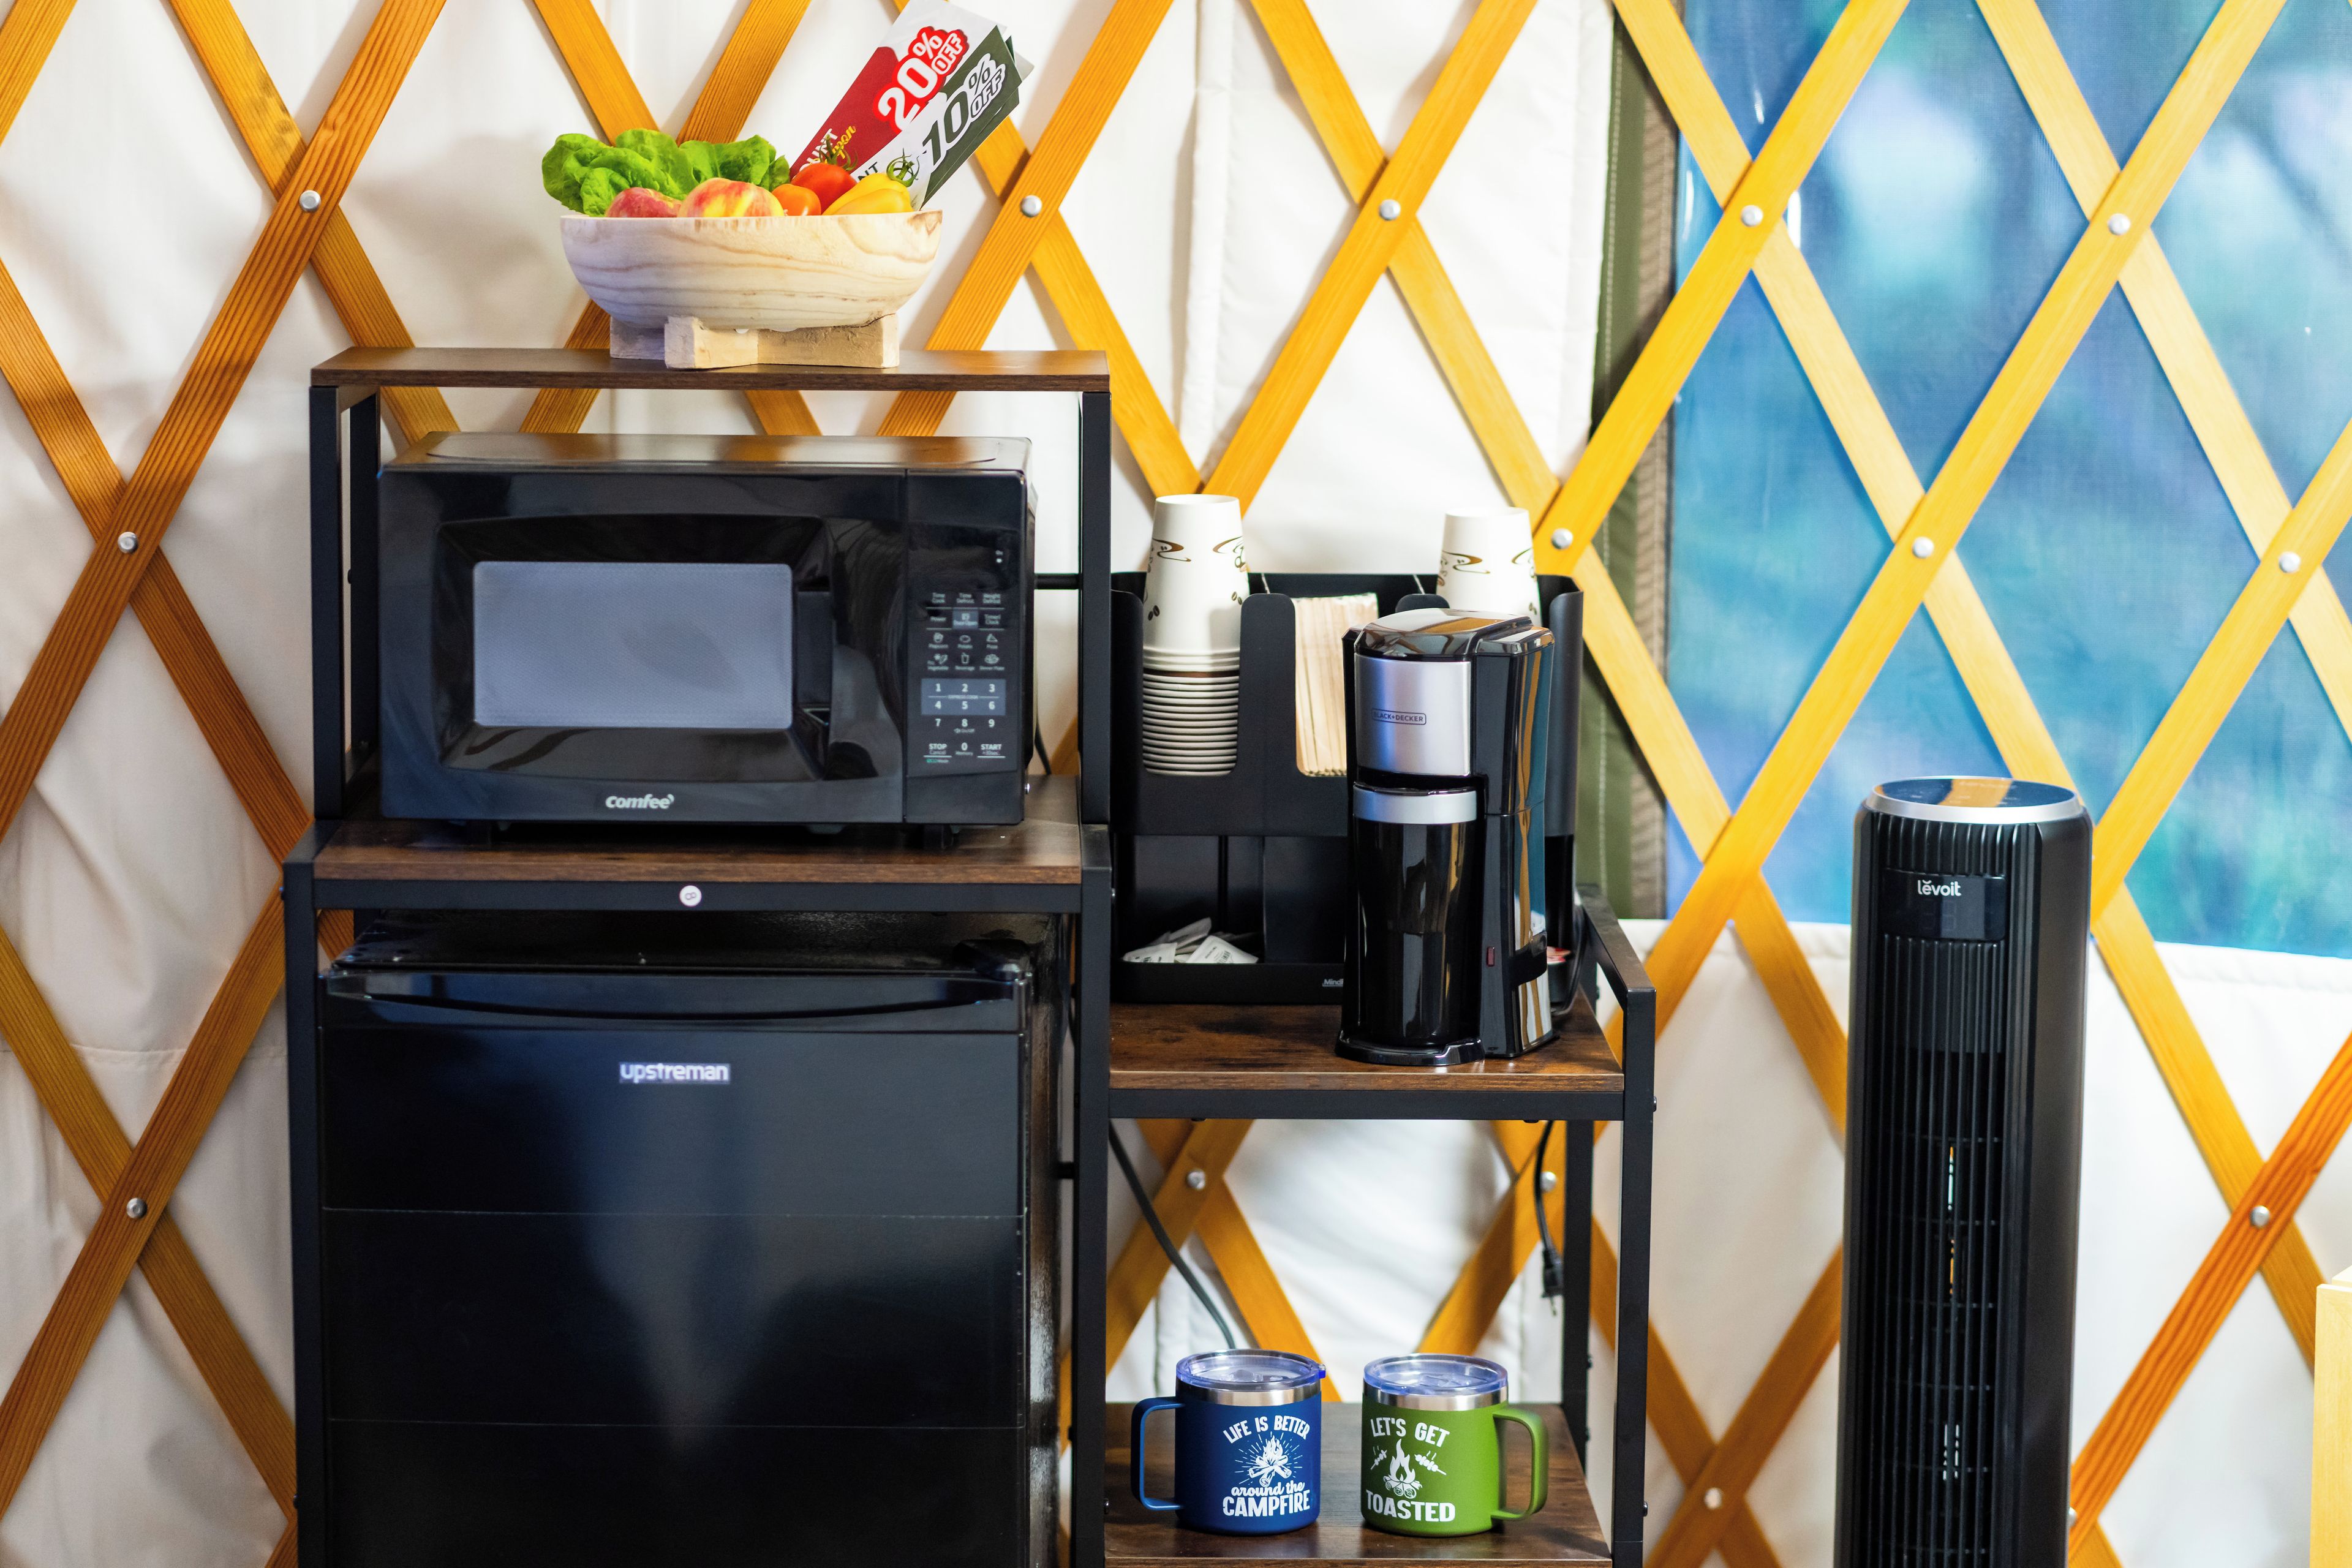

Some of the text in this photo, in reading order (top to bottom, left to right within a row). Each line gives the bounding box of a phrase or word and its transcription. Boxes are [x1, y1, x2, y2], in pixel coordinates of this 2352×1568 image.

[931, 33, 963, 74] OFF
[971, 69, 1002, 118] OFF
[935, 683, 941, 692] 1
[962, 683, 968, 692] 2
[989, 684, 995, 693] 3
[935, 701, 941, 709] 4
[962, 701, 968, 710] 5
[989, 701, 995, 710] 6
[935, 718, 941, 727] 7
[962, 718, 968, 727] 8
[988, 718, 995, 728] 9
[961, 742, 968, 751] 0
[620, 1063, 728, 1084] upstreman
[1223, 1415, 1310, 1444] LIFE IS BETTER
[1370, 1417, 1450, 1447] LET'S GET
[1231, 1480, 1305, 1496] around the
[1223, 1490, 1310, 1517] CAMPFIRE
[1366, 1489, 1455, 1522] TOASTED
